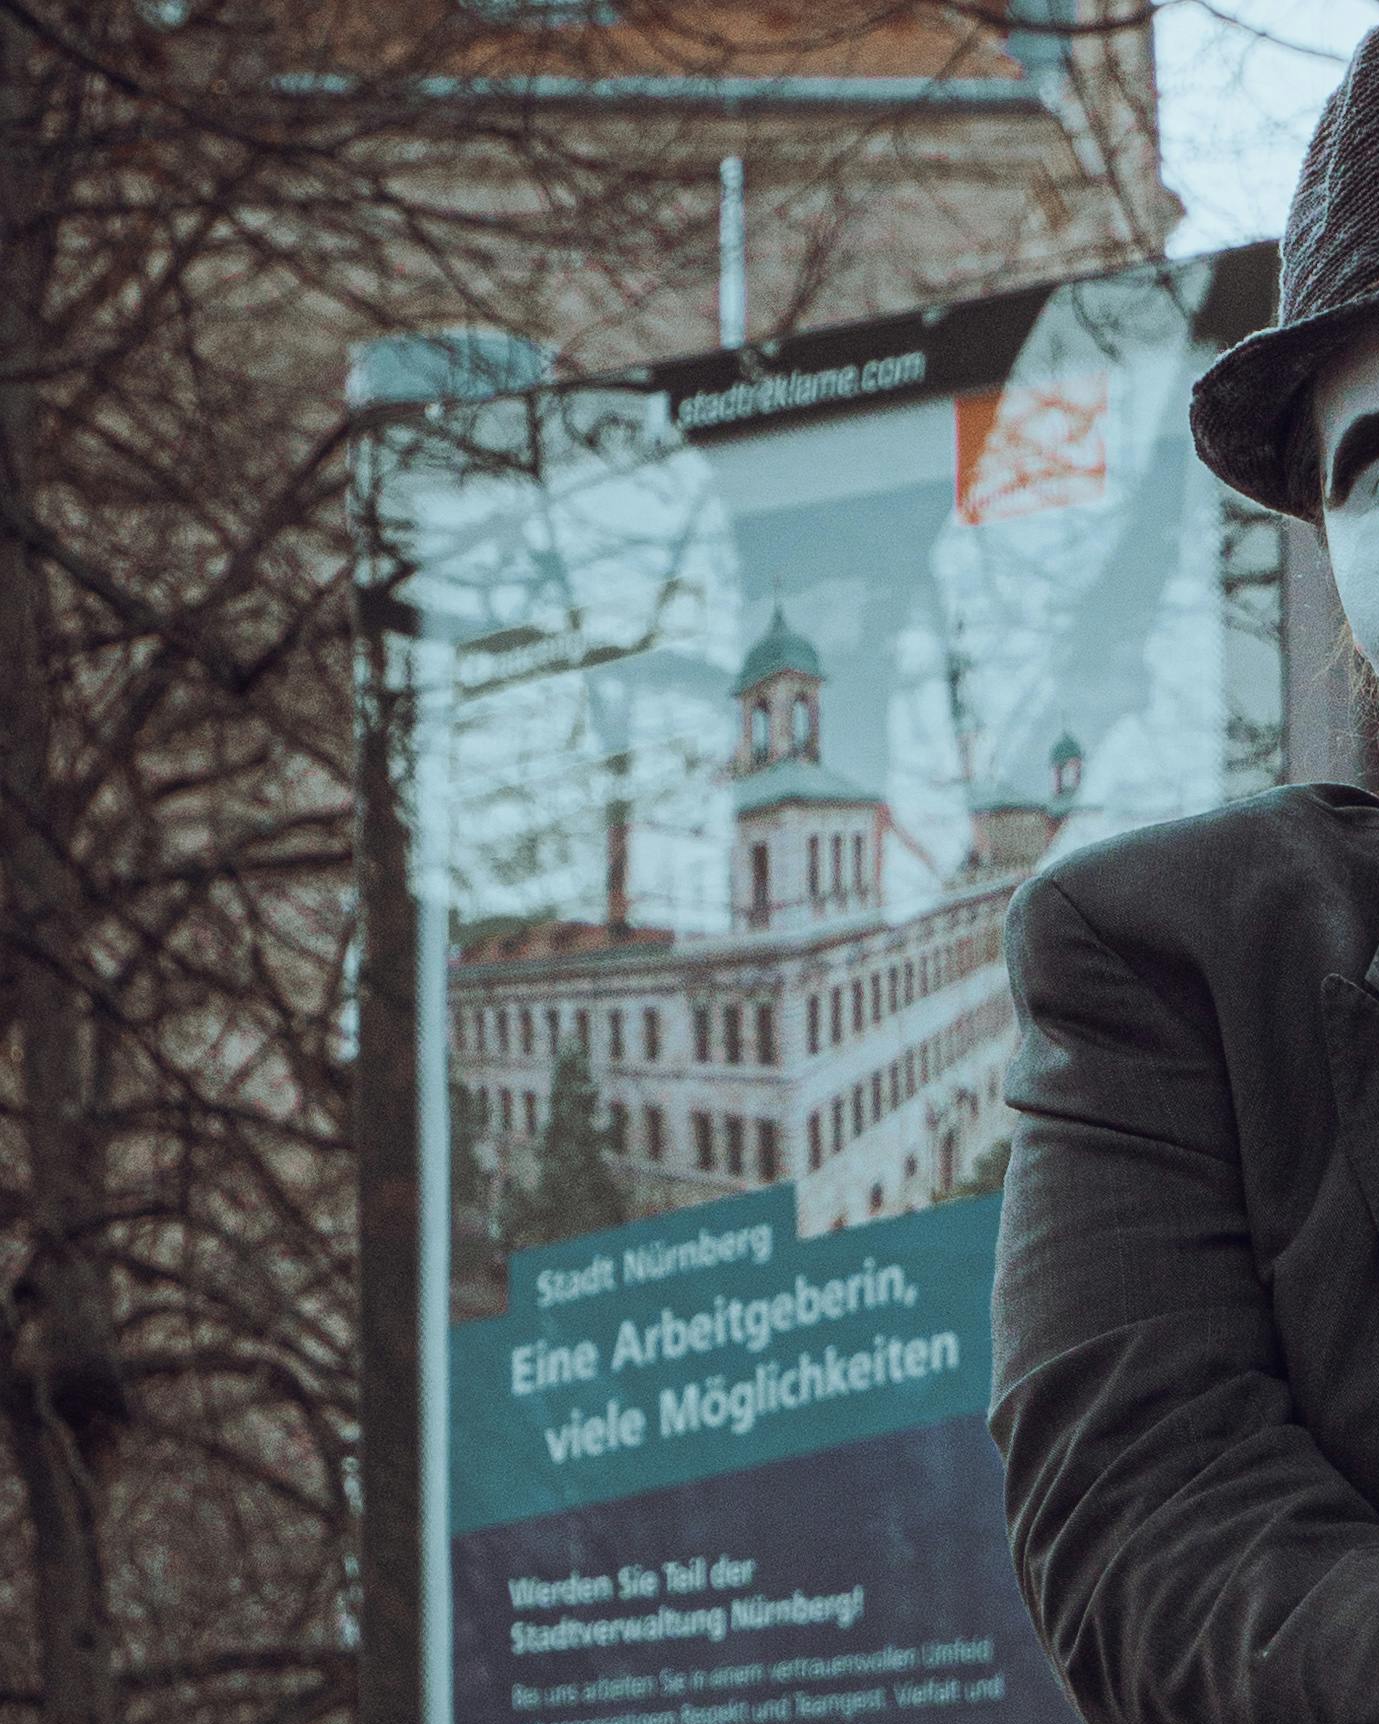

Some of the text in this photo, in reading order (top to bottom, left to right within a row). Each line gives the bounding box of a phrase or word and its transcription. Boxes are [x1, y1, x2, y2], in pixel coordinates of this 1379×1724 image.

[678, 351, 926, 427] stadtreklame.com
[537, 1224, 773, 1307] Stadt Nürnberg
[511, 1257, 917, 1396] Eine Arbeitgeberin,
[545, 1331, 959, 1464] viele Möglichkeiten
[508, 1554, 757, 1608] Werden Sie Teil der
[511, 1584, 864, 1655] Stadtverwaltung Nürnberg!
